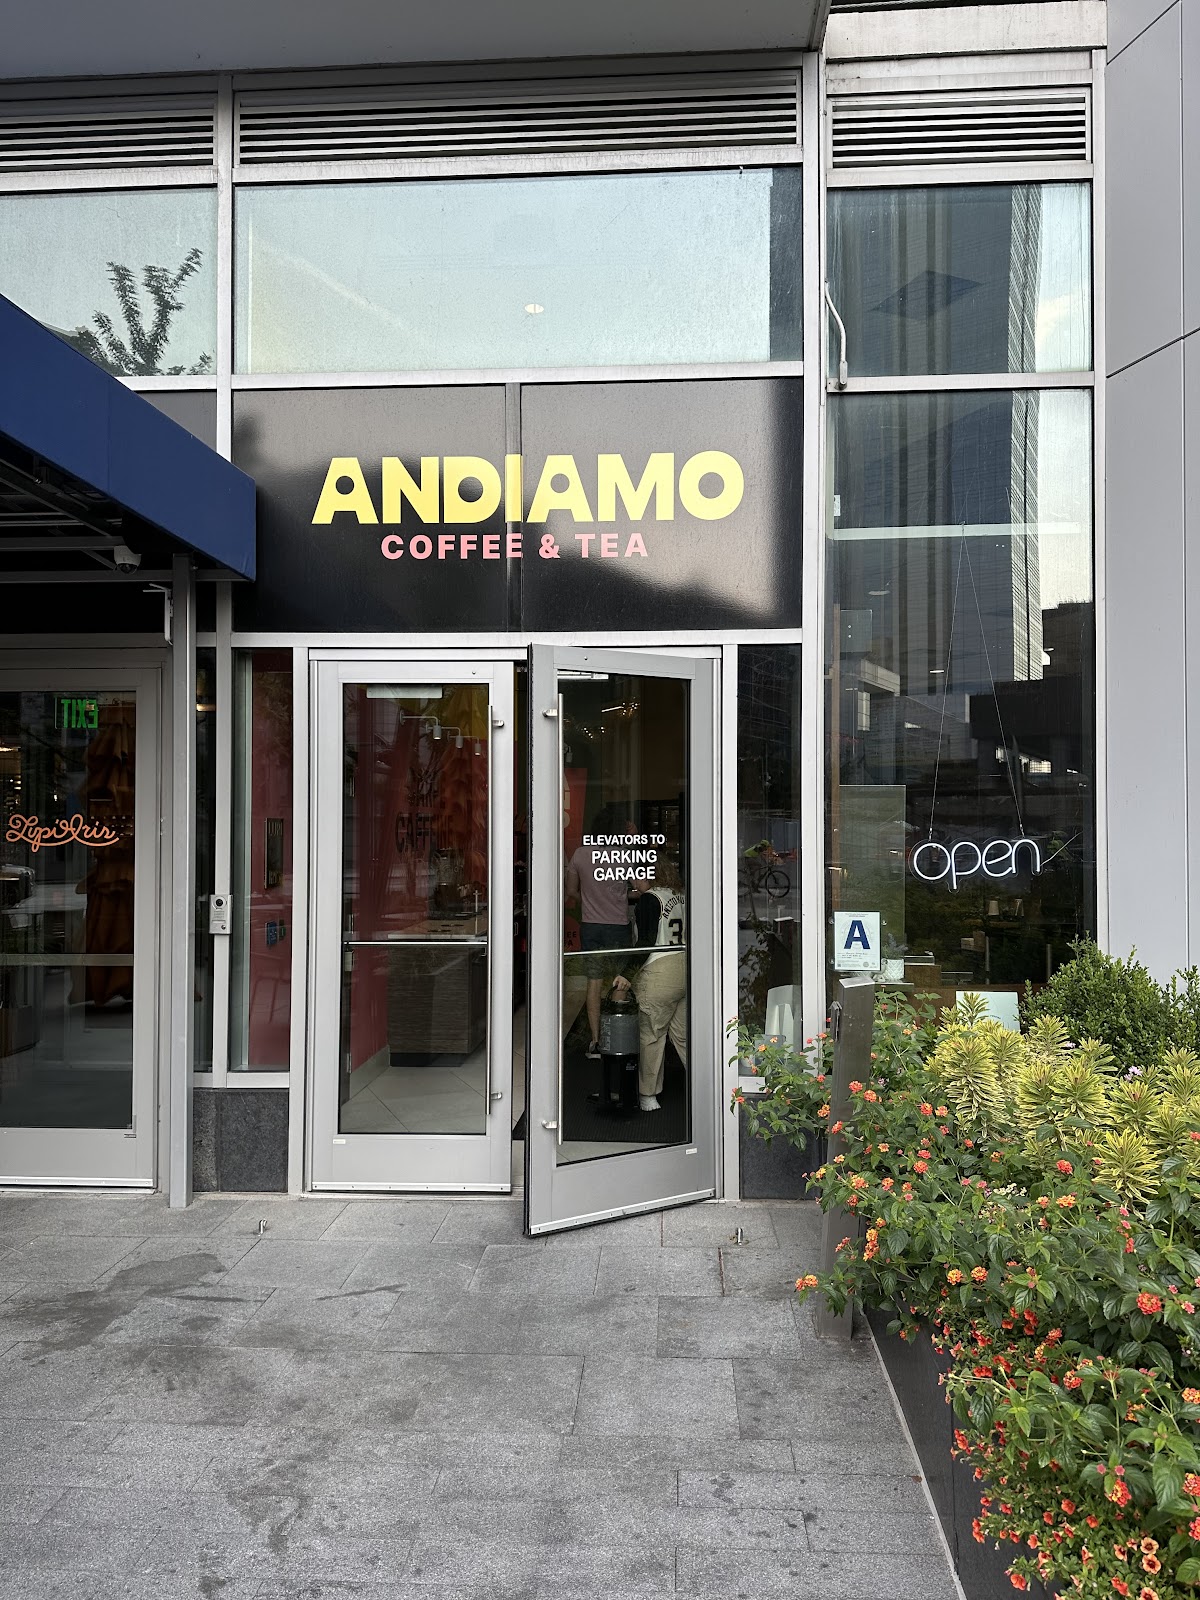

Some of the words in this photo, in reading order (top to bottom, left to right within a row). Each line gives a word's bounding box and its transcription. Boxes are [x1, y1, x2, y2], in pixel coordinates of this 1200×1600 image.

[311, 450, 745, 525] ANDIAMO
[380, 533, 523, 560] COFFEE
[538, 533, 560, 559] &
[574, 532, 648, 558] TEA
[582, 834, 648, 846] ELEVATORS
[649, 833, 666, 845] TO
[591, 849, 658, 865] PARKING
[913, 839, 1041, 890] open
[593, 866, 656, 882] GARAGE
[843, 919, 871, 950] A
